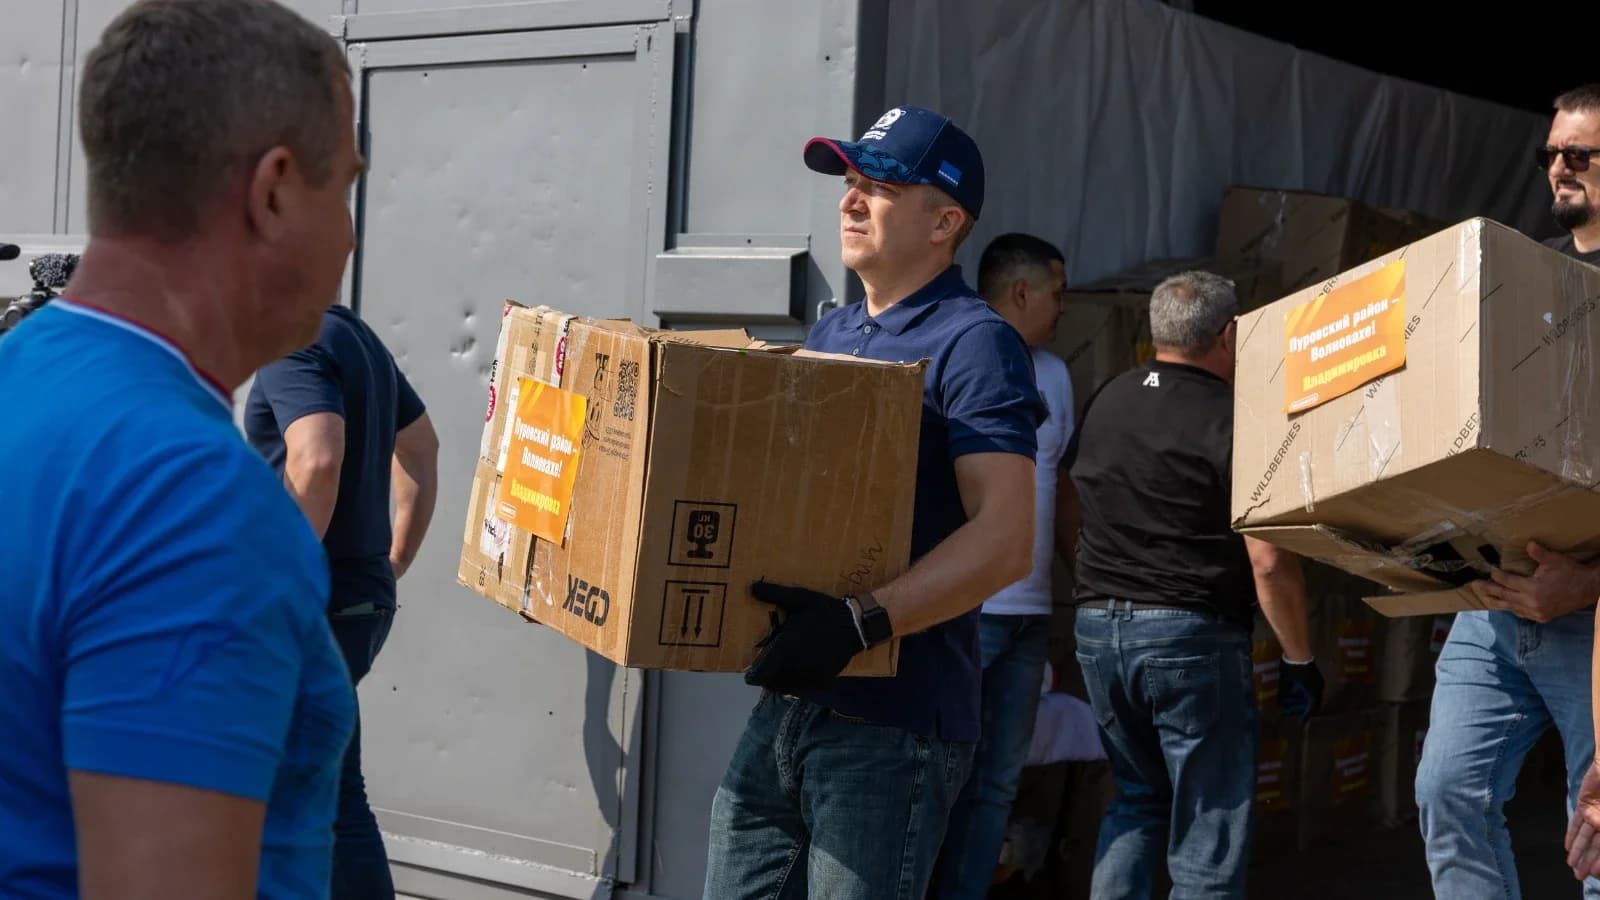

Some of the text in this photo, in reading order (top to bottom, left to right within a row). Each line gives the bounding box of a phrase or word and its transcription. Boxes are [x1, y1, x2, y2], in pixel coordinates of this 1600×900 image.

[1288, 314, 1351, 353] Пуровский
[1353, 298, 1389, 328] район
[1310, 320, 1376, 363] Волновахе!
[1250, 422, 1302, 502] WILDBERRIES
[693, 523, 715, 540] 30
[562, 573, 610, 627] CDEK
